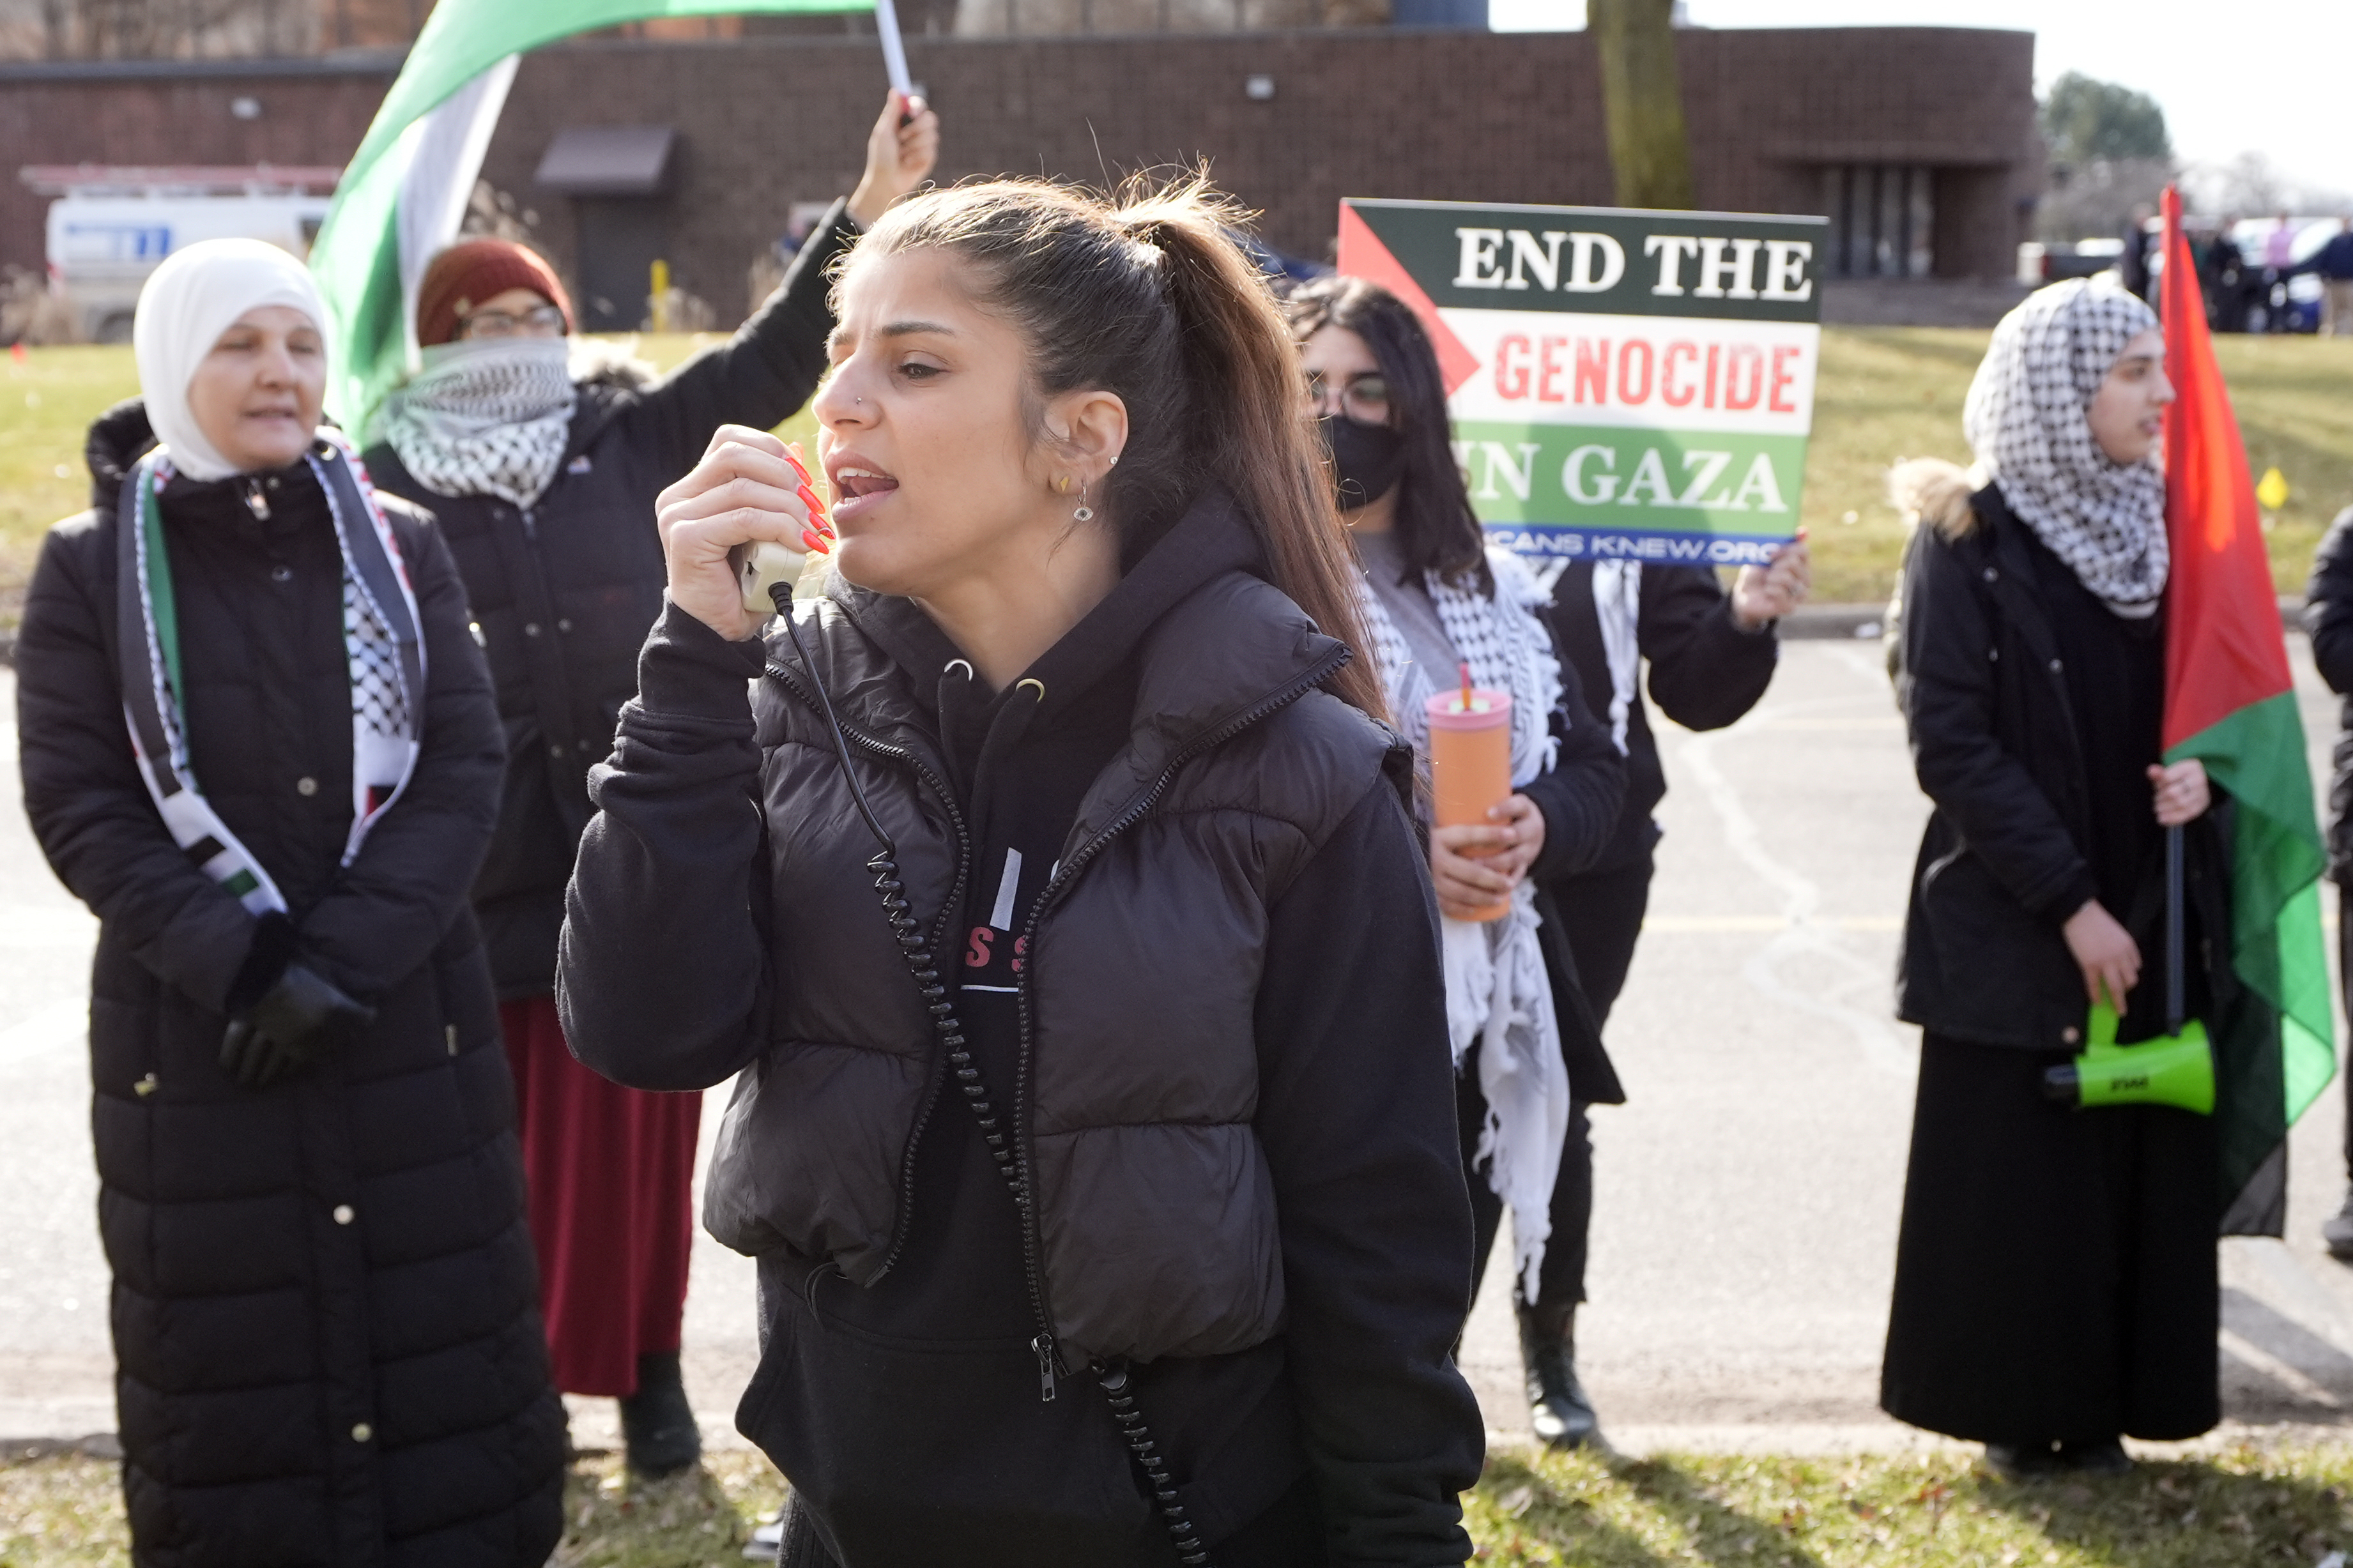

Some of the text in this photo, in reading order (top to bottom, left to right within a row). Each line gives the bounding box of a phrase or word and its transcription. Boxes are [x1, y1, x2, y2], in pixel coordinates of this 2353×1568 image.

[1452, 227, 1813, 302] END THE
[1495, 333, 1800, 412] GENOCIDE
[1561, 443, 1788, 514] GAZA
